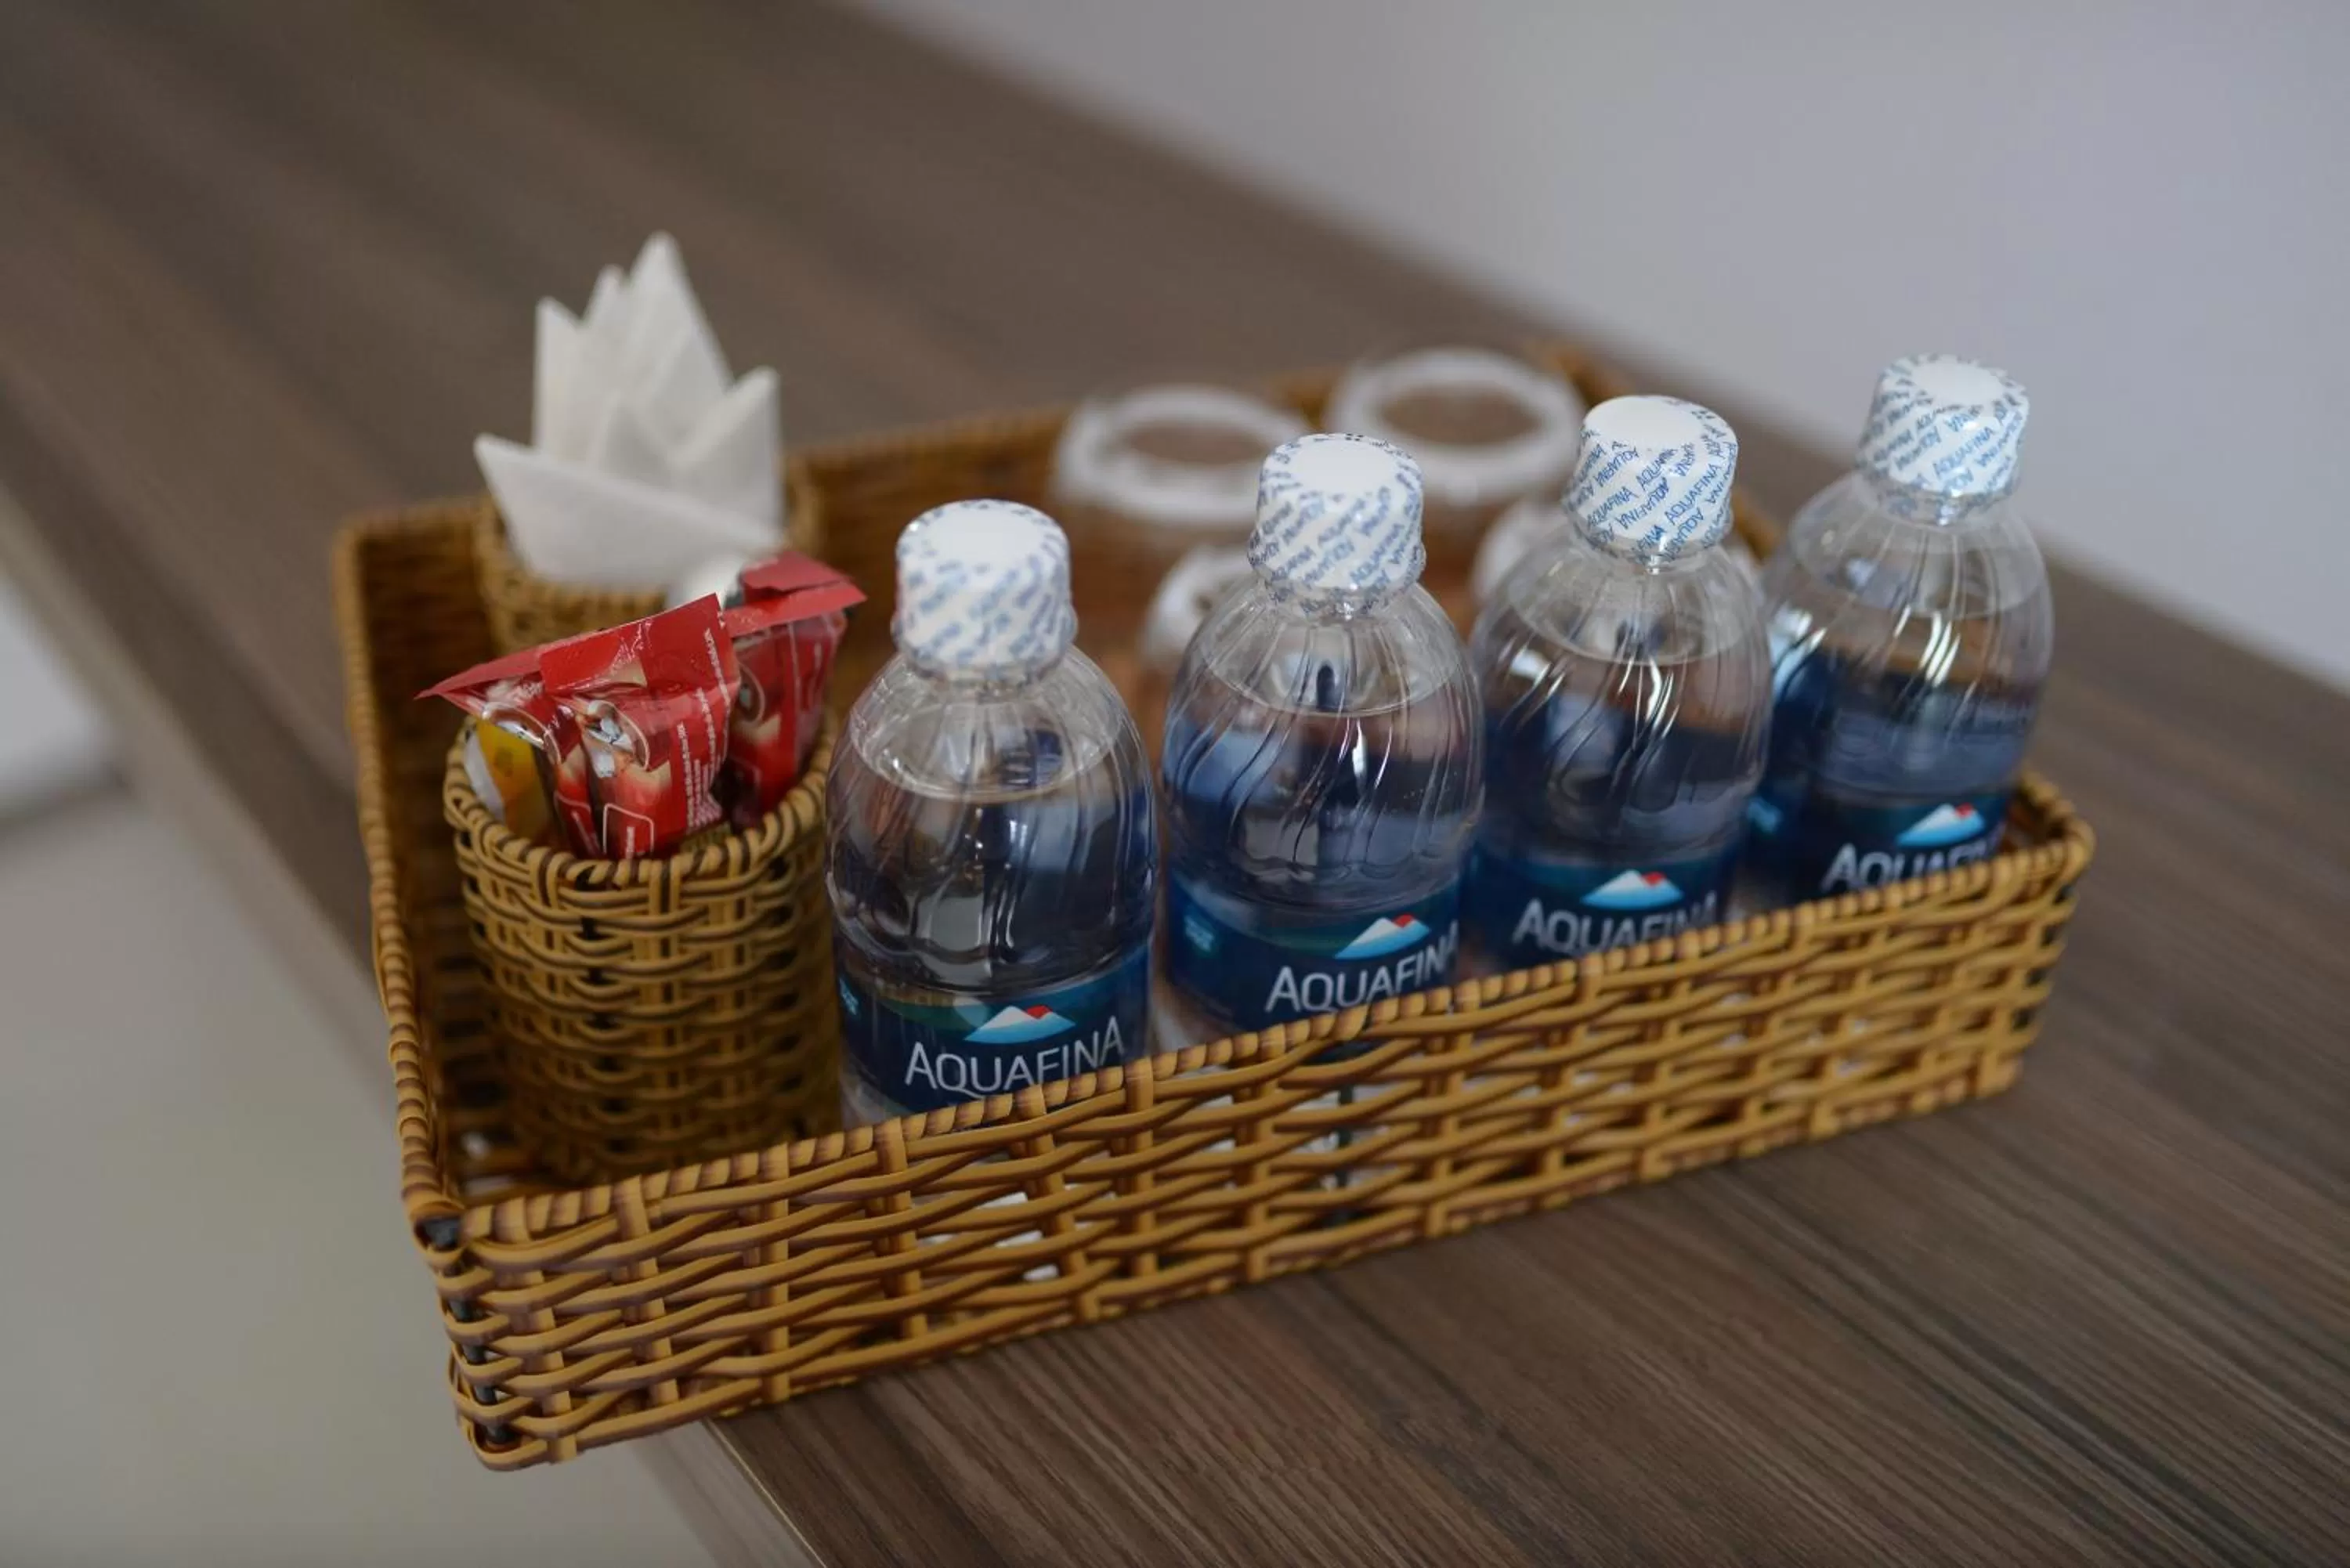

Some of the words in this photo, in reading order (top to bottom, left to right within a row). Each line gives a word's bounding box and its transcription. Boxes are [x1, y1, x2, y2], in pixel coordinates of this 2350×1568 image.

[1614, 476, 1669, 530] AQUAFINA
[1665, 463, 1723, 526] AQUAFINA
[905, 1016, 1126, 1100] AQUAFINA
